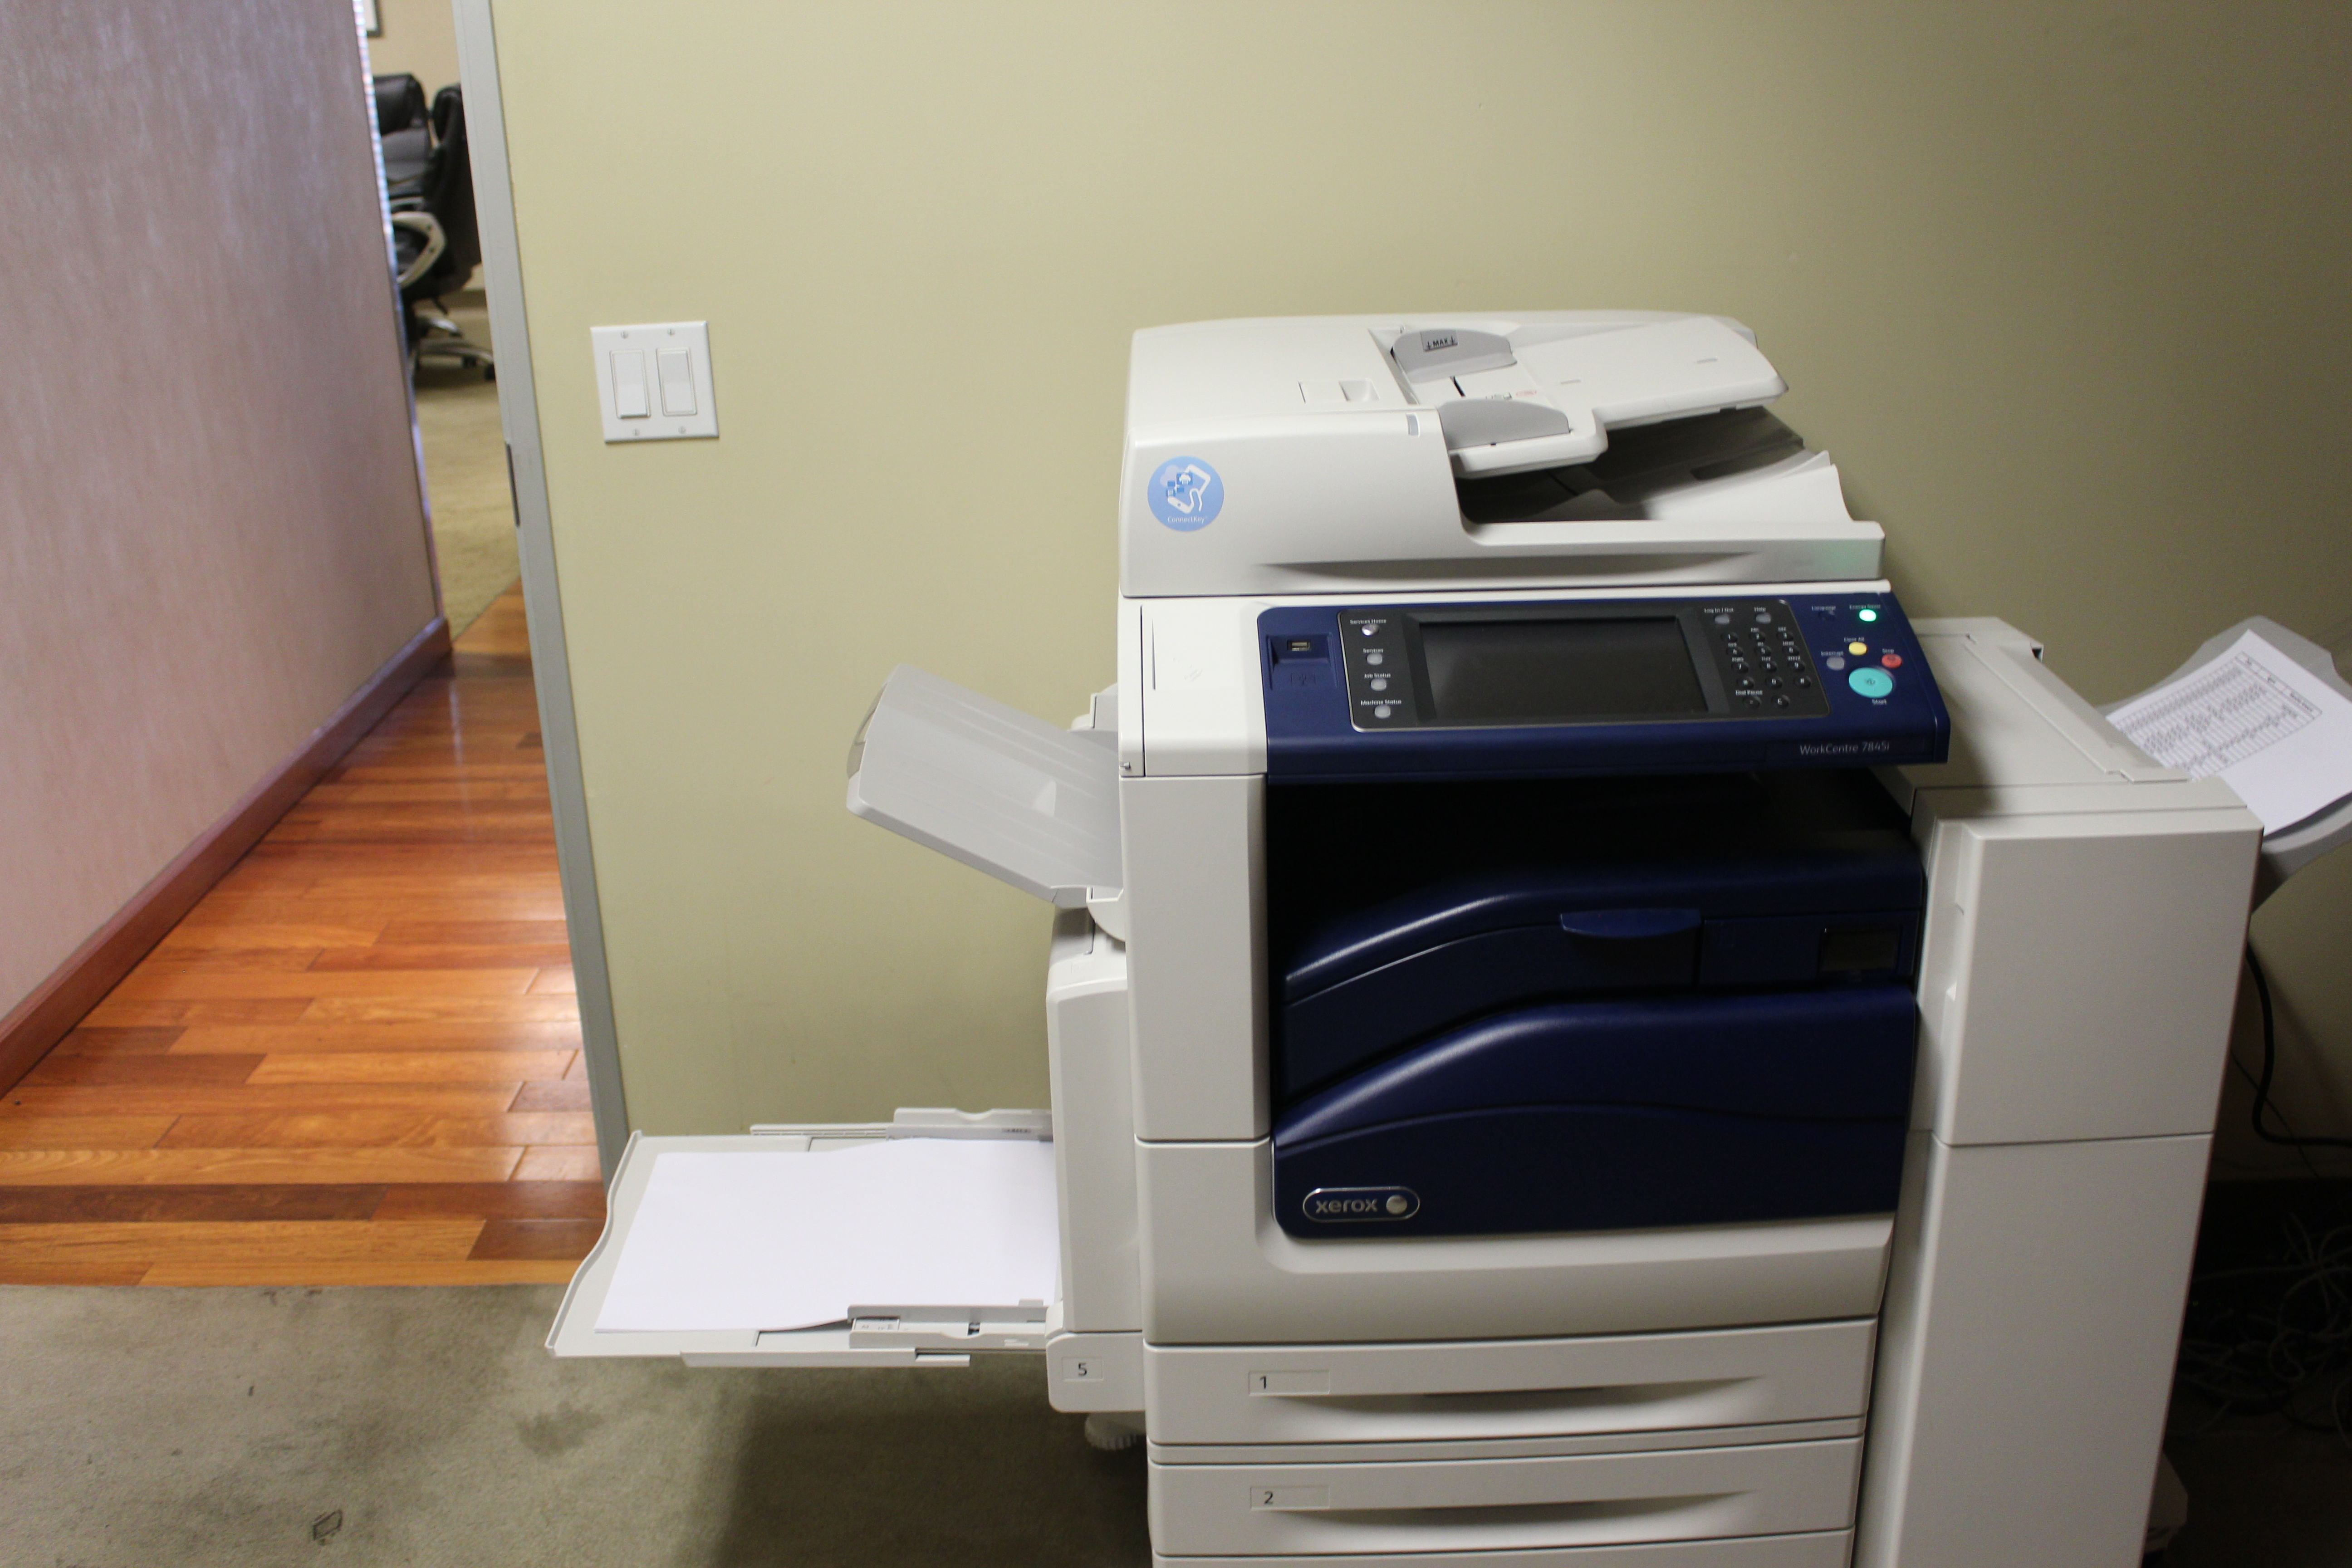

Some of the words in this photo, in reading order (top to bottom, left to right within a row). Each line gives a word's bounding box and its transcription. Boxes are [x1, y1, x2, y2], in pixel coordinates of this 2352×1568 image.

[1433, 338, 1448, 347] MAX
[1800, 744, 1858, 755] WorkCentre
[1862, 741, 1889, 752] 7845i
[1316, 1199, 1378, 1214] xerox
[1078, 1362, 1087, 1376] 5
[1260, 1375, 1266, 1389] 1
[1264, 1491, 1273, 1504] 2
